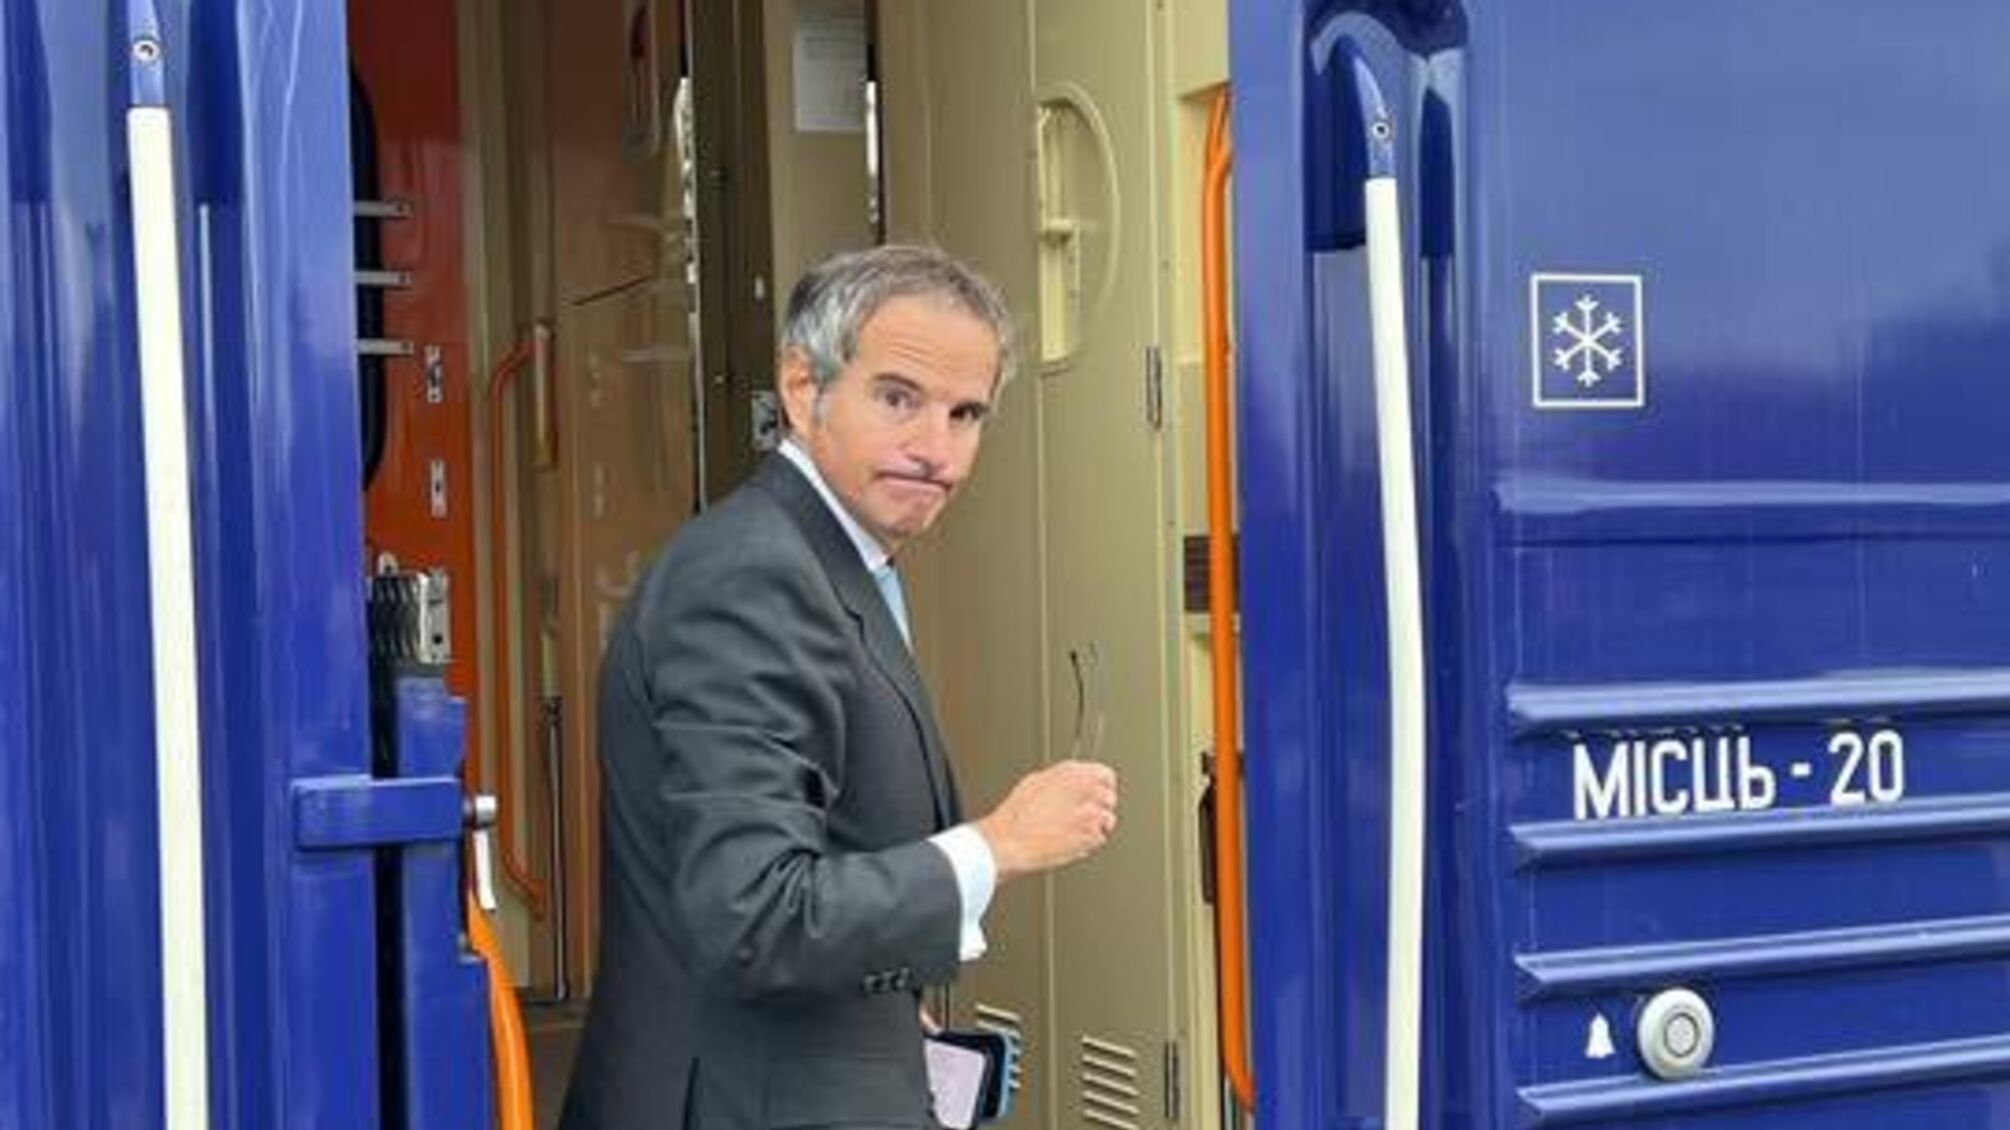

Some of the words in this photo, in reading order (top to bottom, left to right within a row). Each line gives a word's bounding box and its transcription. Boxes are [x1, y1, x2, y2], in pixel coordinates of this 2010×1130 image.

[1574, 736, 1776, 820] МІСЦЬ
[1791, 762, 1811, 777] -
[1828, 729, 1904, 805] 20
